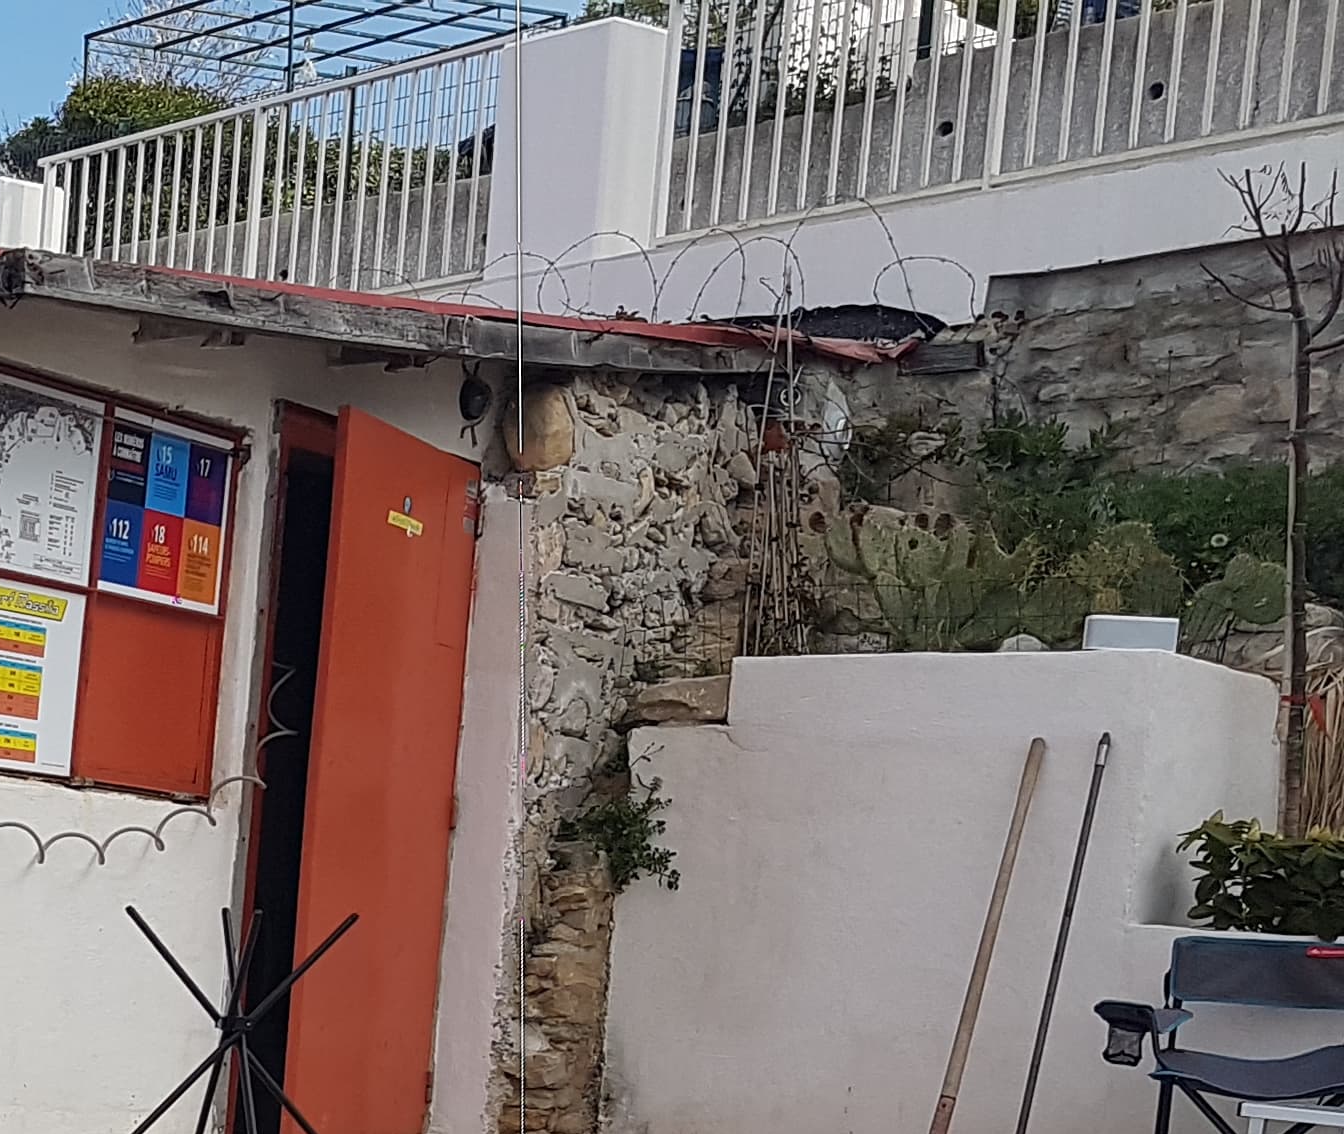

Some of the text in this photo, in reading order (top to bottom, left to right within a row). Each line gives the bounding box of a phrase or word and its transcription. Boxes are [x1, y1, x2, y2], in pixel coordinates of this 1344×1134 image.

[160, 445, 174, 465] 15
[154, 462, 178, 481] SAMU
[199, 457, 212, 478] 17
[111, 518, 131, 541] 112
[153, 523, 167, 544] 18
[191, 534, 209, 555] 114
